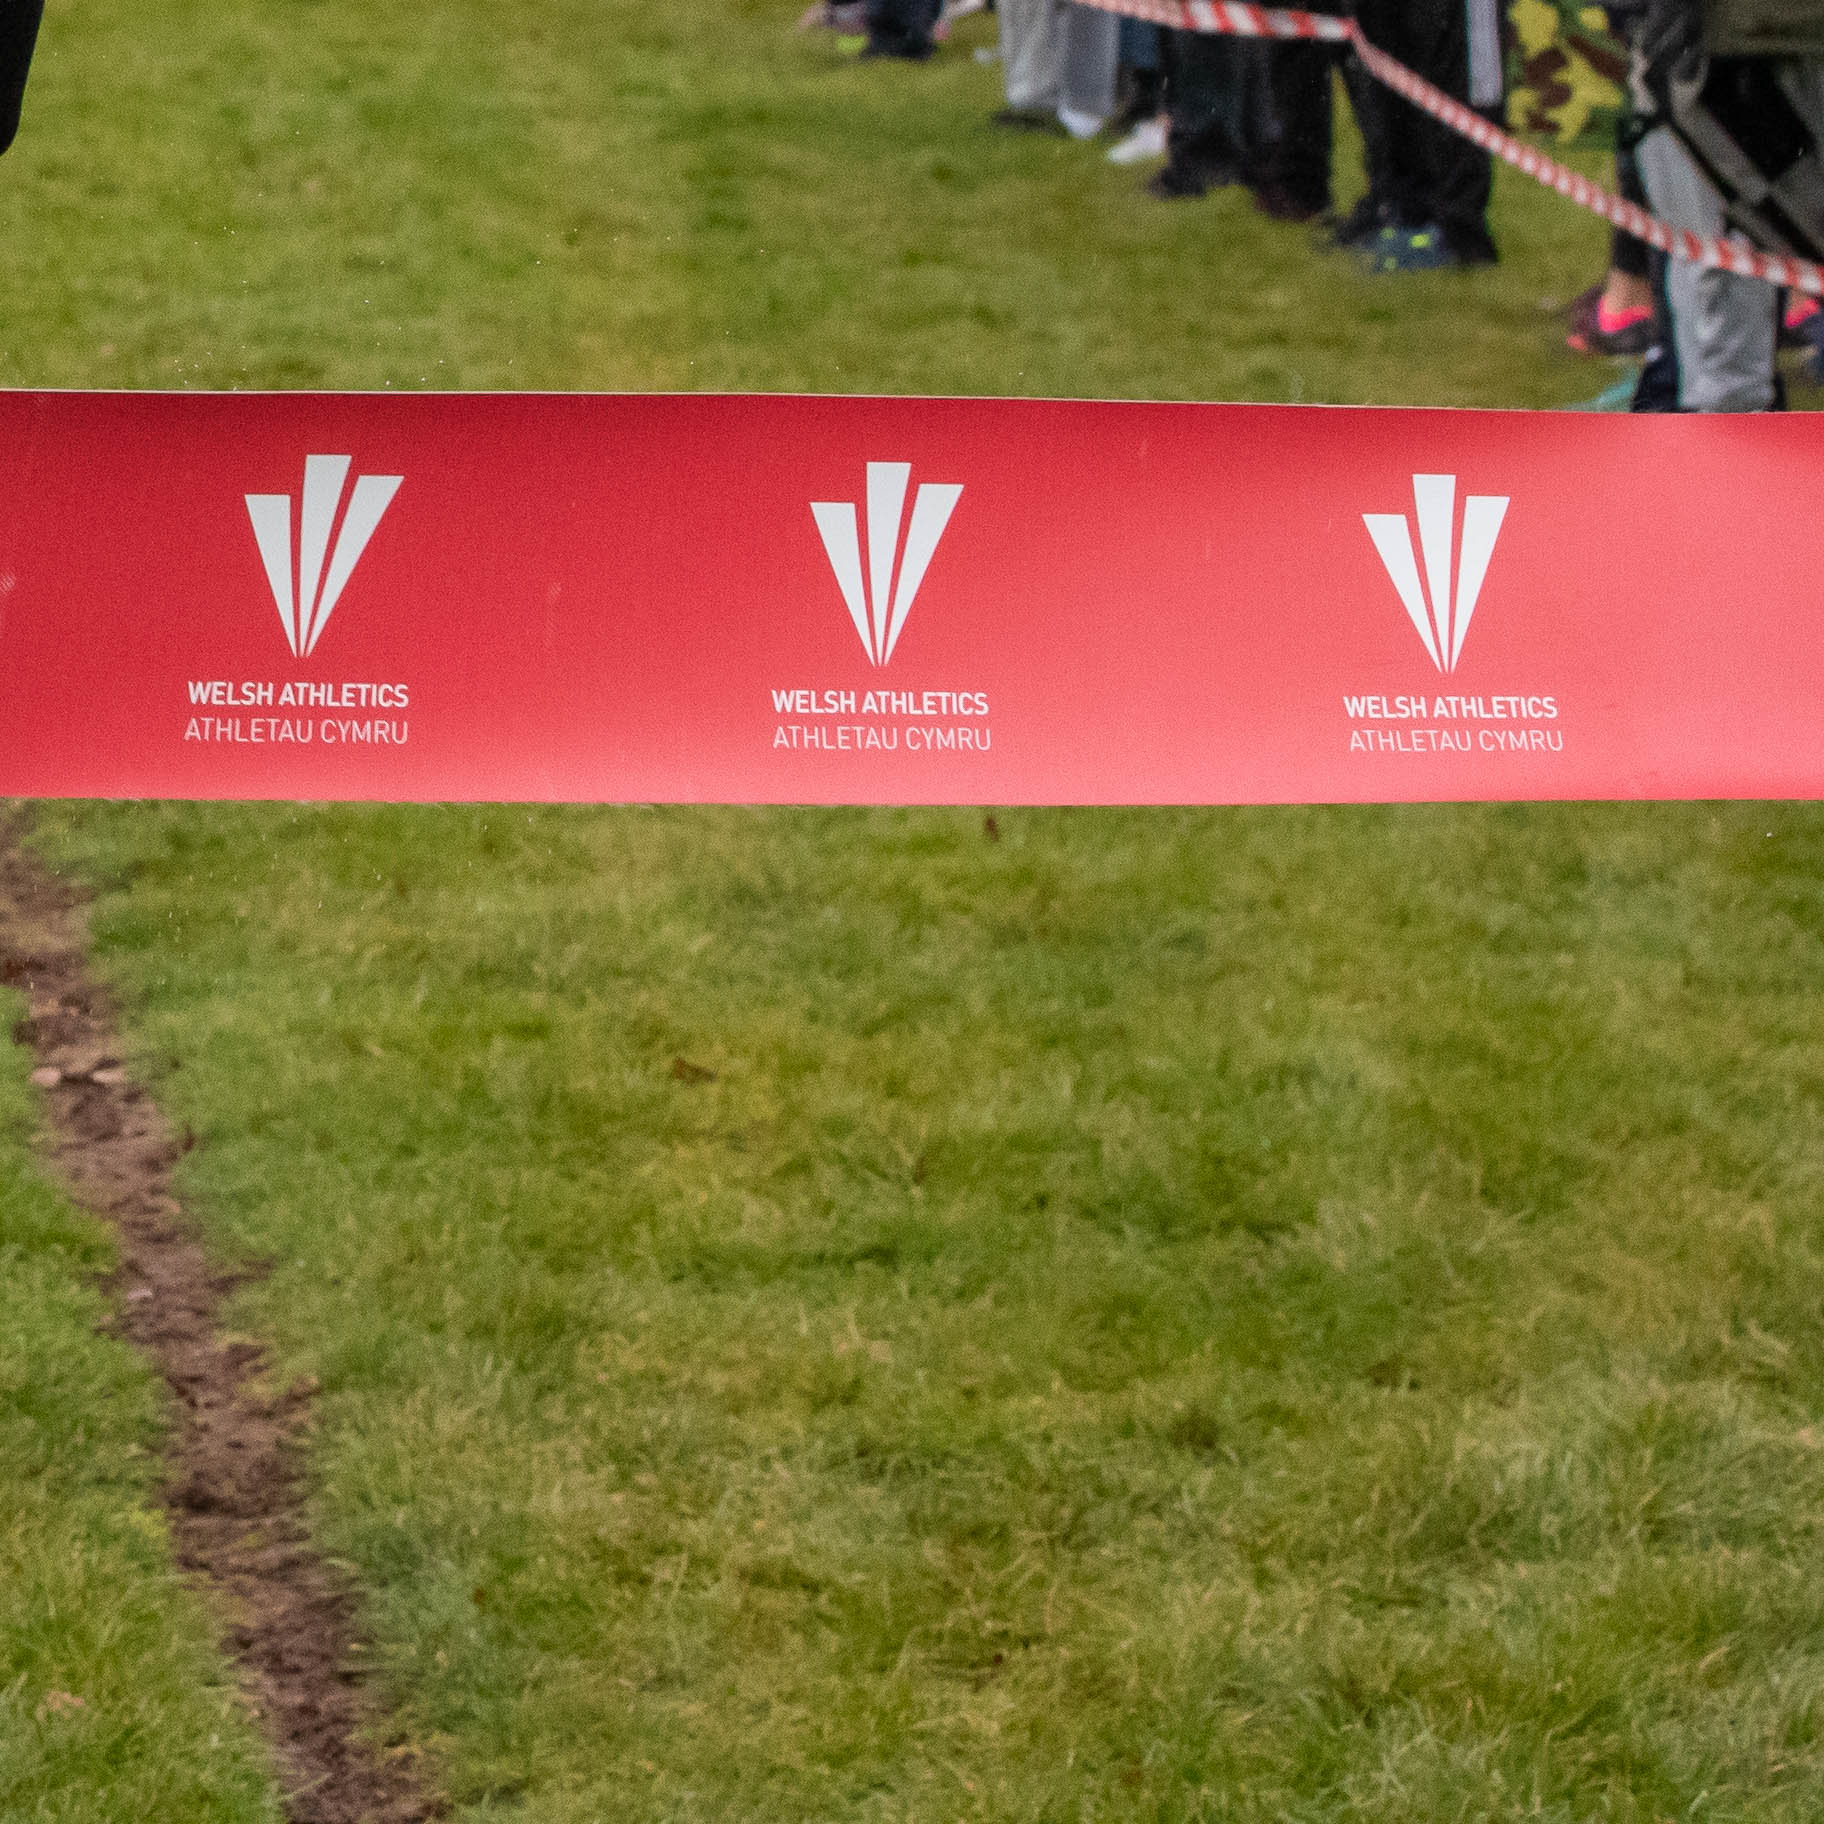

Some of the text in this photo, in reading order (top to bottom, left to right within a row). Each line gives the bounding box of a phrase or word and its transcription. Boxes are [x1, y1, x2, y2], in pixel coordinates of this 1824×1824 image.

[187, 680, 410, 708] WELSH ATHLETICS
[770, 689, 990, 716] WELSH ATHLETICS
[1343, 695, 1559, 720] WELSH ATHLETICS
[183, 716, 409, 745] ATHLETAU CYMRU
[771, 725, 992, 752] ATHLETAU CYMRU
[1348, 729, 1564, 753] ATHLETAU CYMRU
